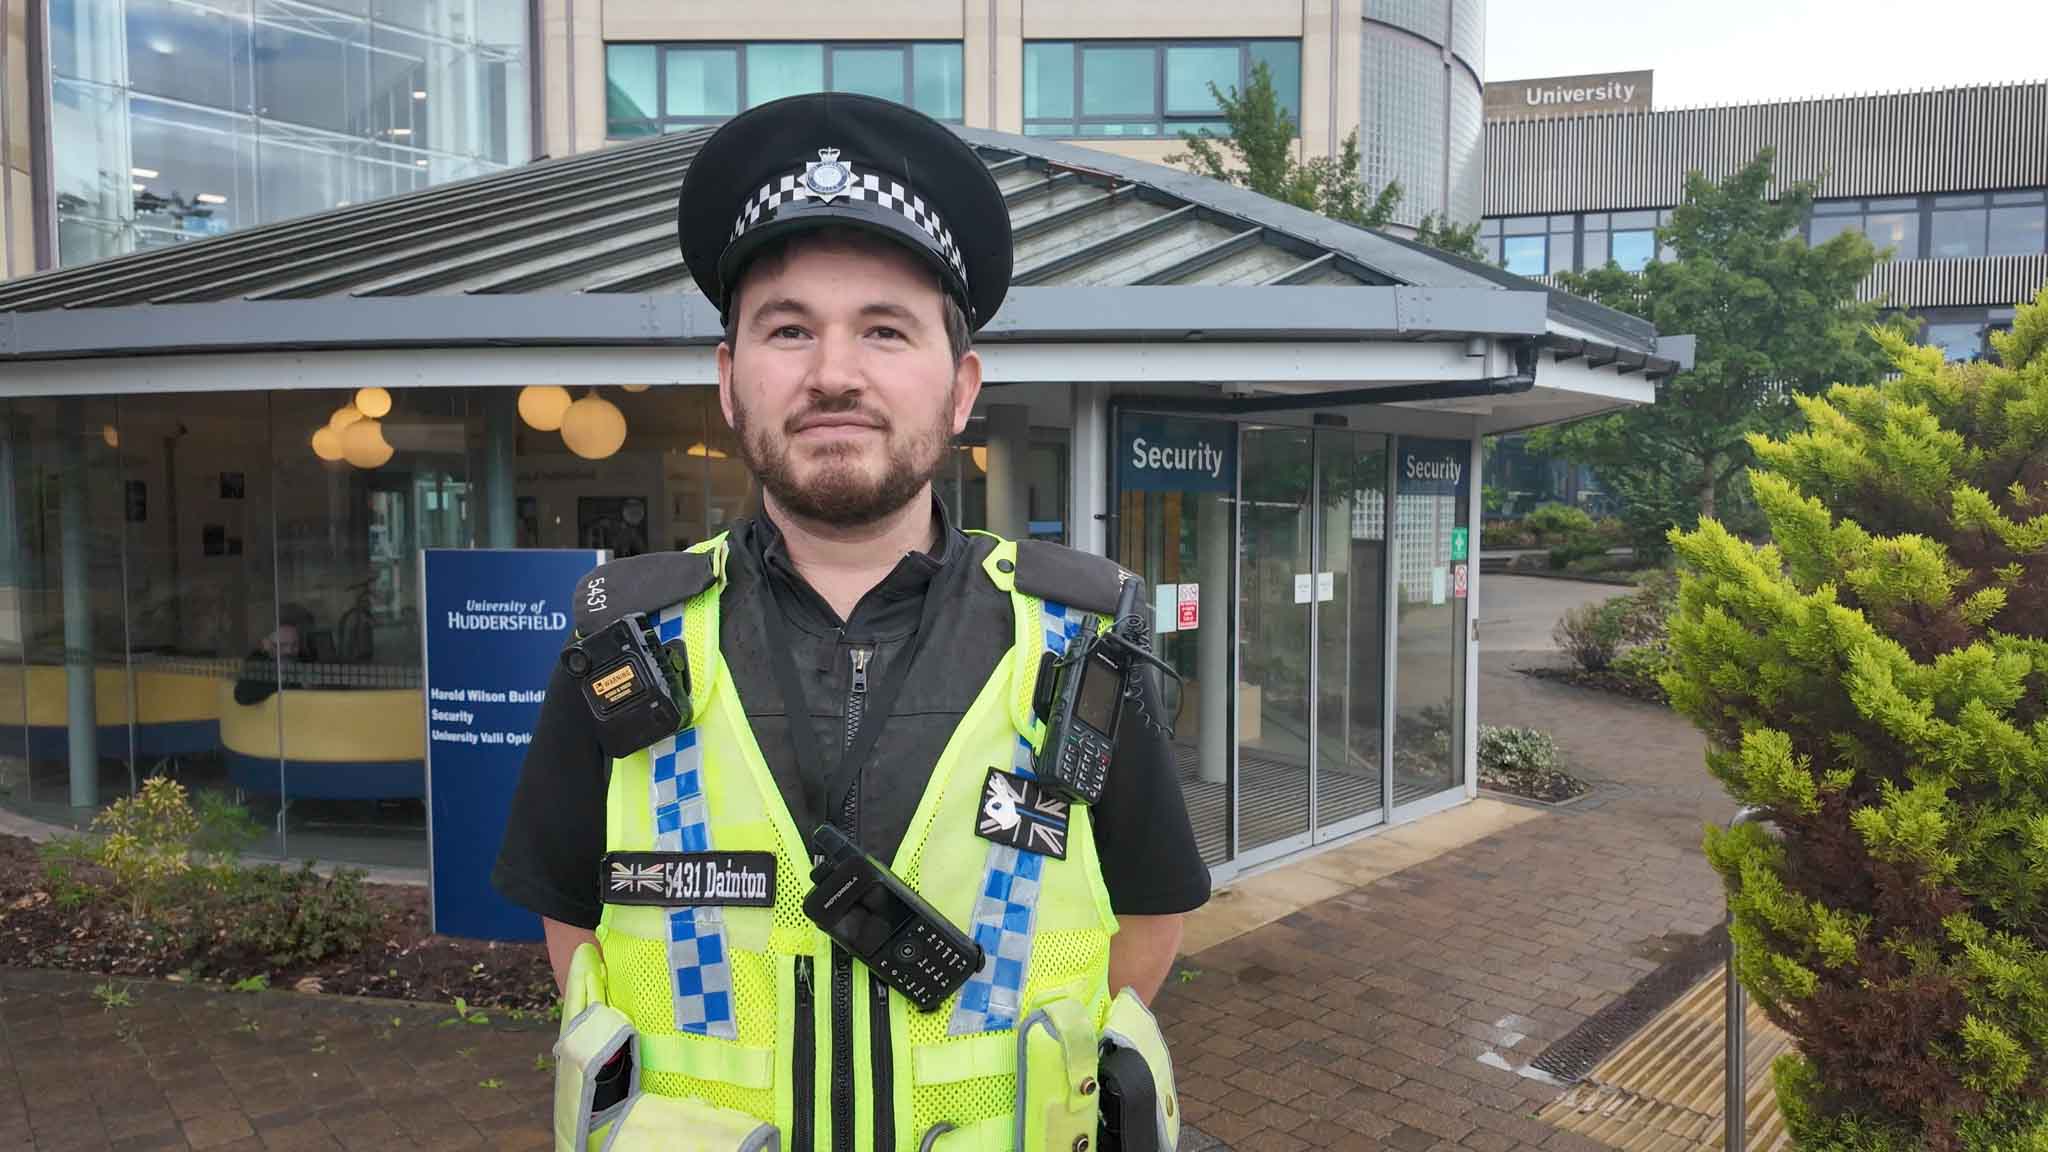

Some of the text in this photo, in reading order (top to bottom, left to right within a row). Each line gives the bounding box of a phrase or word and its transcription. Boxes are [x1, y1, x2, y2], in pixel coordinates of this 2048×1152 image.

[1526, 81, 1635, 105] University
[1132, 437, 1223, 478] Security
[1406, 455, 1462, 485] Security
[466, 600, 546, 613] University of
[587, 577, 608, 613] 5431
[431, 688, 465, 701] Harold
[467, 690, 505, 703] Wilson
[431, 708, 474, 725] Security
[431, 730, 478, 745] University
[480, 732, 504, 744] Valli
[665, 859, 767, 898] 5431 Dainton
[824, 876, 858, 909] MOTOROLA
